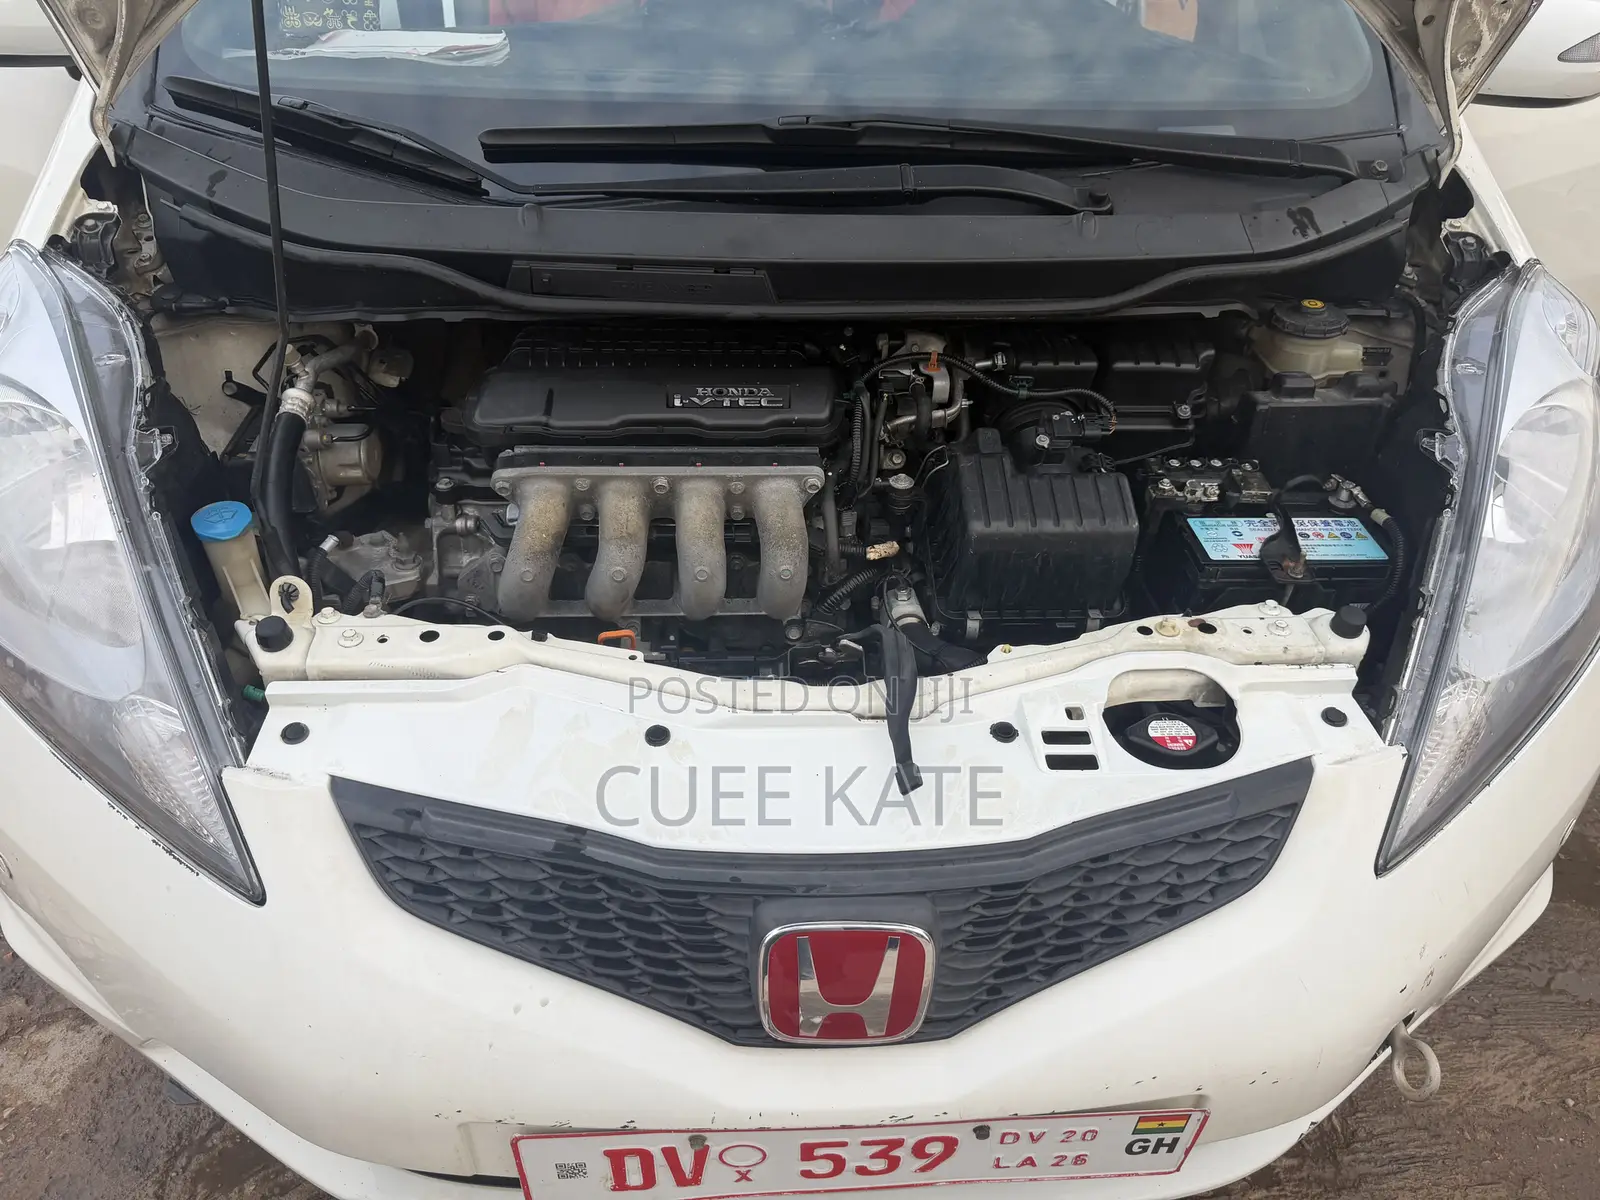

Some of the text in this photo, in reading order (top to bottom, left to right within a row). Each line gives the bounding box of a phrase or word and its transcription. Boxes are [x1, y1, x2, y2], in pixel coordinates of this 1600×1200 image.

[696, 387, 775, 396] HONDA
[674, 394, 783, 407] i-VTEC
[1124, 1136, 1180, 1156] GH
[602, 1144, 711, 1192] DV
[799, 1135, 960, 1179] 539
[992, 1155, 1038, 1169] LA
